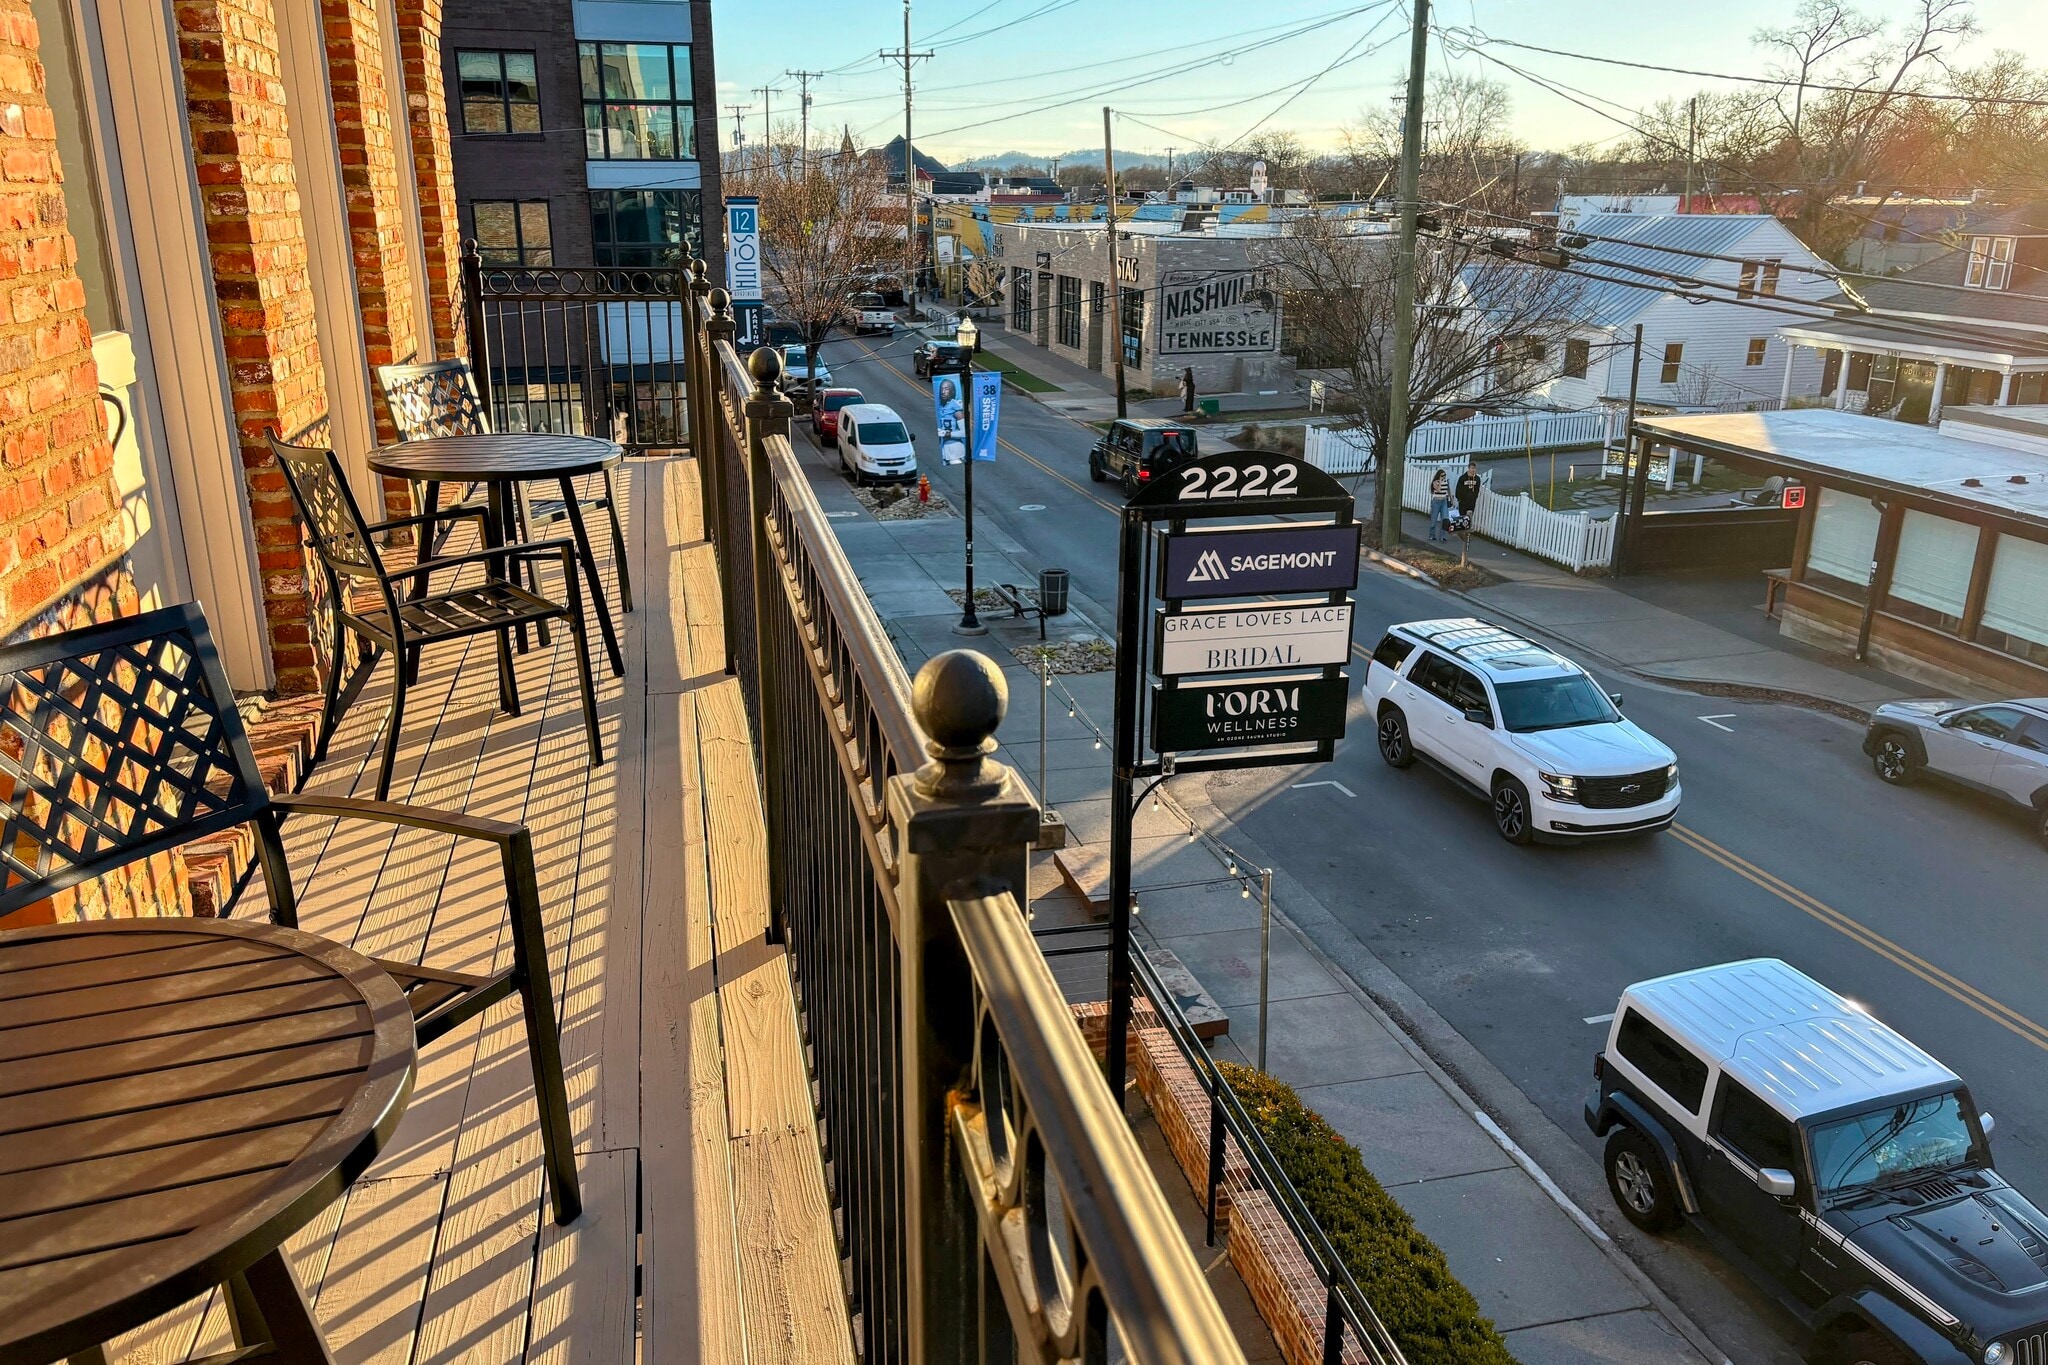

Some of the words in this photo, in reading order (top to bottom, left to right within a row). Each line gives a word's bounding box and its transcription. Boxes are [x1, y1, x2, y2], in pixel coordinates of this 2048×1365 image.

[735, 211, 750, 231] 12
[733, 234, 757, 289] SOUTH
[1117, 256, 1139, 283] STAG
[751, 308, 760, 345] PARKING
[1166, 330, 1270, 349] TENNESSEE
[983, 384, 996, 395] 38
[982, 397, 991, 431] SNEED
[1178, 463, 1298, 500] 2222
[1230, 551, 1337, 572] SAGEMONT
[1165, 615, 1227, 632] GRACE
[1236, 611, 1293, 628] LOVES
[1206, 644, 1301, 669] BRIDAL
[1206, 686, 1300, 718] FORM
[1207, 716, 1298, 734] WELLNESS
